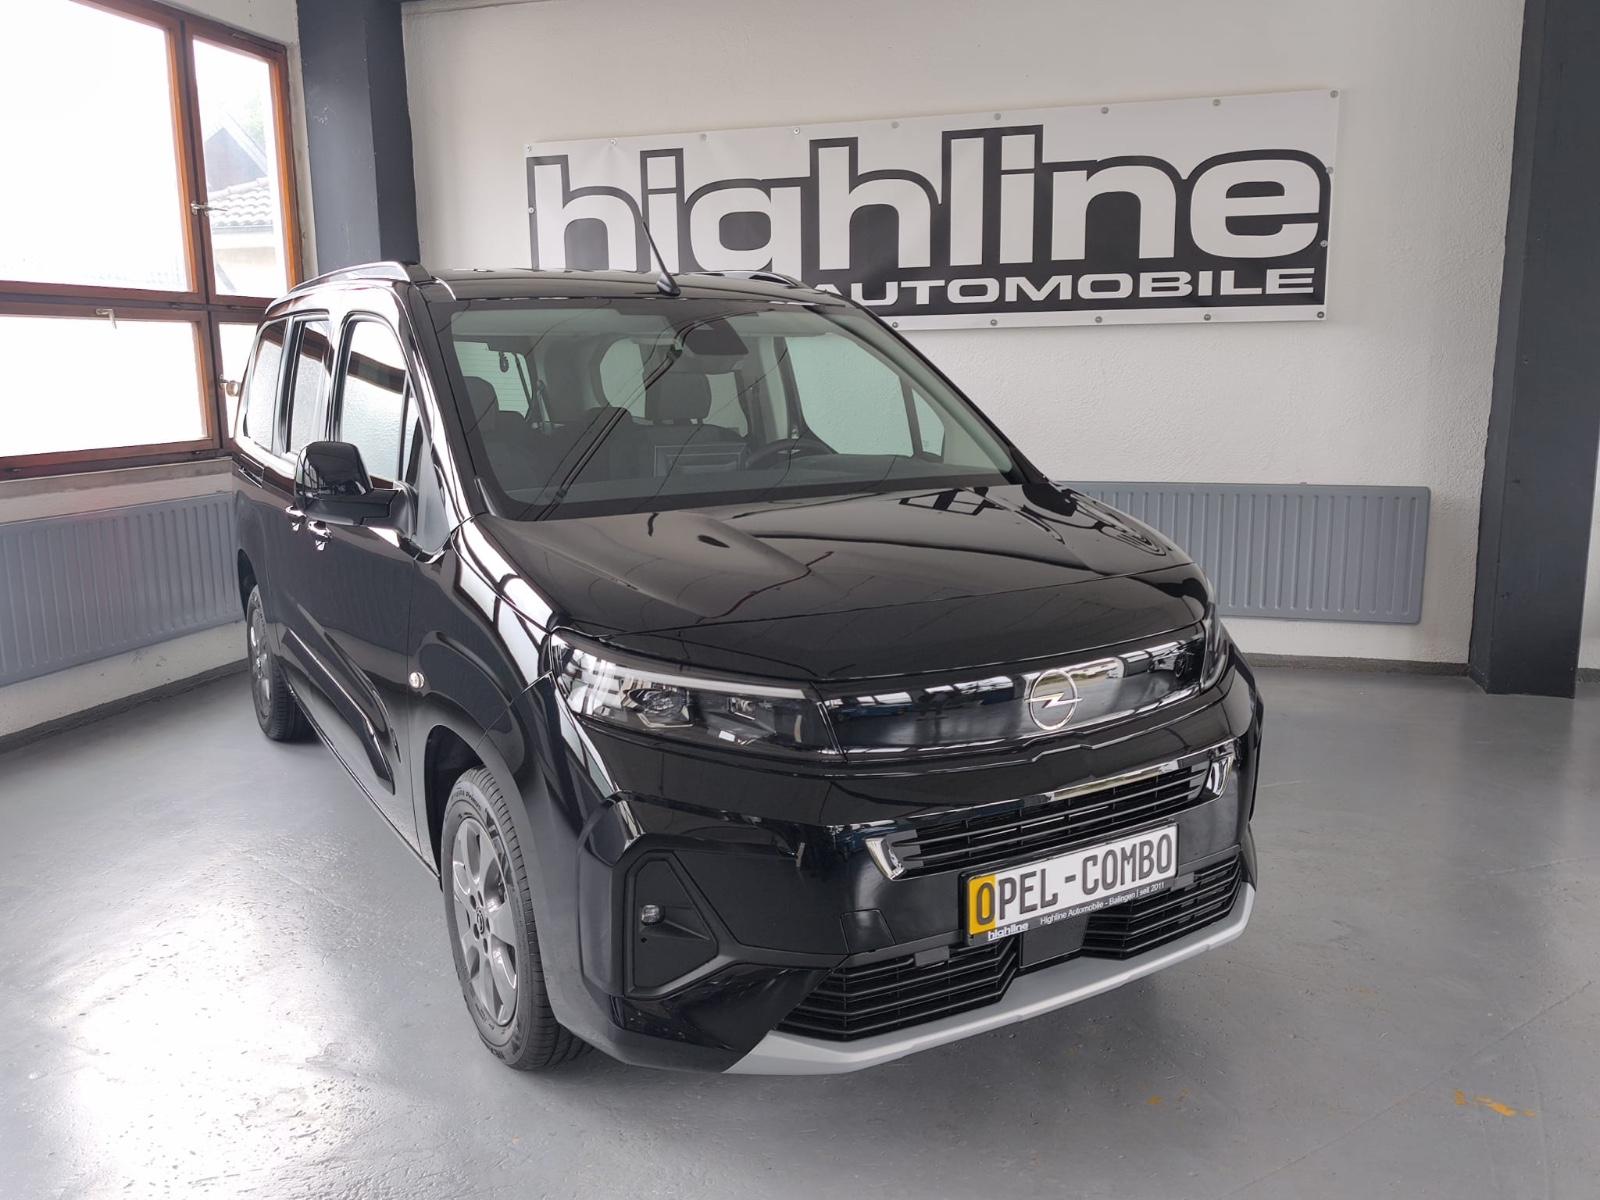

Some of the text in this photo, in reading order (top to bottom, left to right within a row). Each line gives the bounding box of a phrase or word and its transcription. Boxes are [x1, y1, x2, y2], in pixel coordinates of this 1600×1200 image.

[527, 124, 1331, 281] highline
[1040, 911, 1068, 925] Highline
[1068, 902, 1104, 918] Automobile
[1150, 881, 1165, 892] 2011
